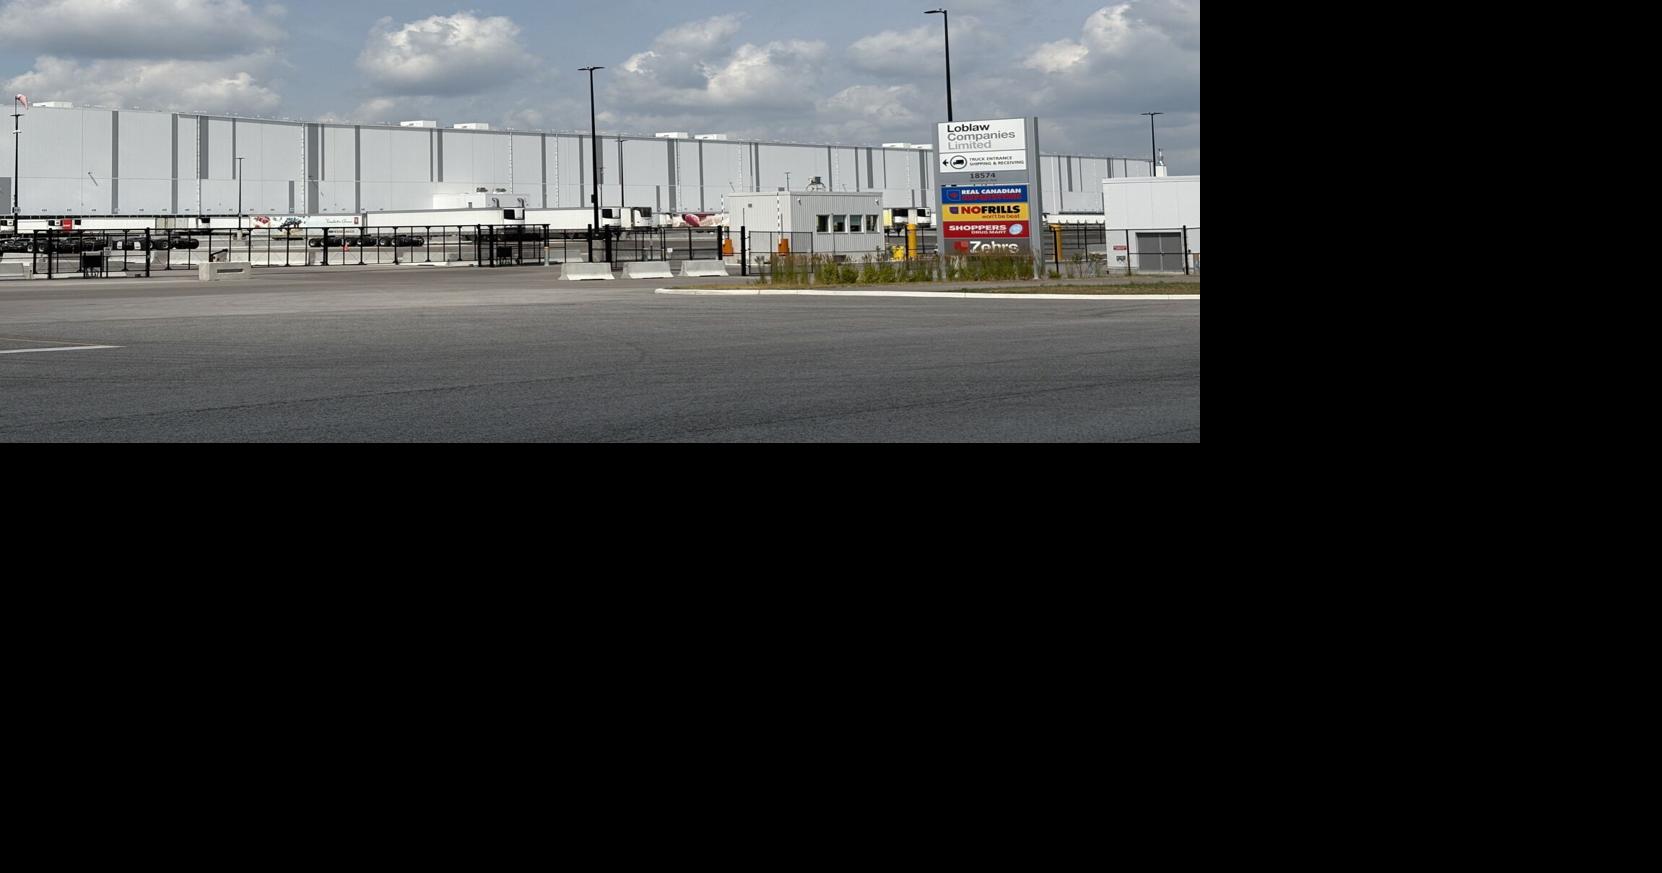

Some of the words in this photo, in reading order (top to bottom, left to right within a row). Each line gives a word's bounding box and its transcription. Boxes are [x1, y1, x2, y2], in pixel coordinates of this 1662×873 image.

[947, 124, 990, 132] Loblaw
[947, 130, 1016, 141] Companies
[948, 140, 992, 150] Limited
